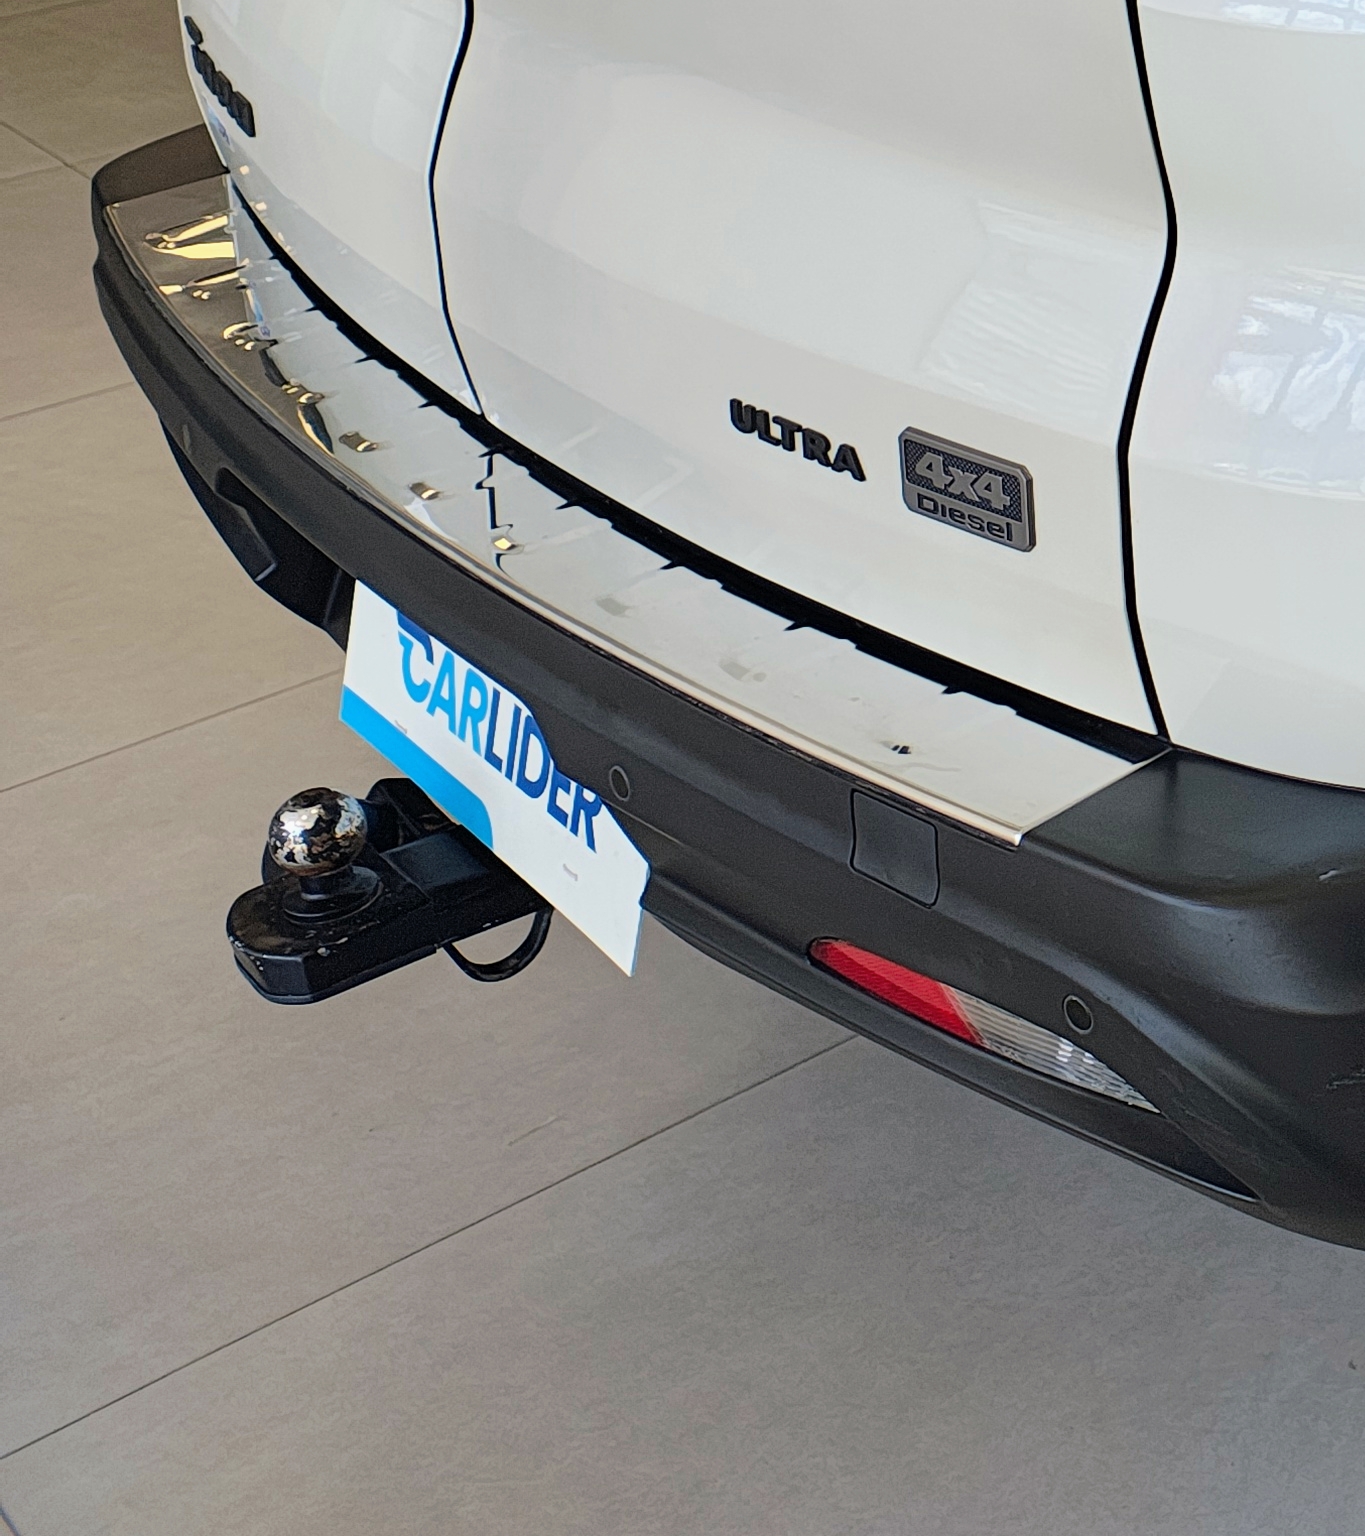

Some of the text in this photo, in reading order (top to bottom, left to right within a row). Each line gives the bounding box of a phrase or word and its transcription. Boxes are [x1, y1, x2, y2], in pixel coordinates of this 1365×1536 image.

[729, 398, 867, 482] ULTRA
[915, 451, 1012, 511] 4x4
[916, 492, 1014, 542] Diesel
[396, 610, 604, 854] CARLIDER
